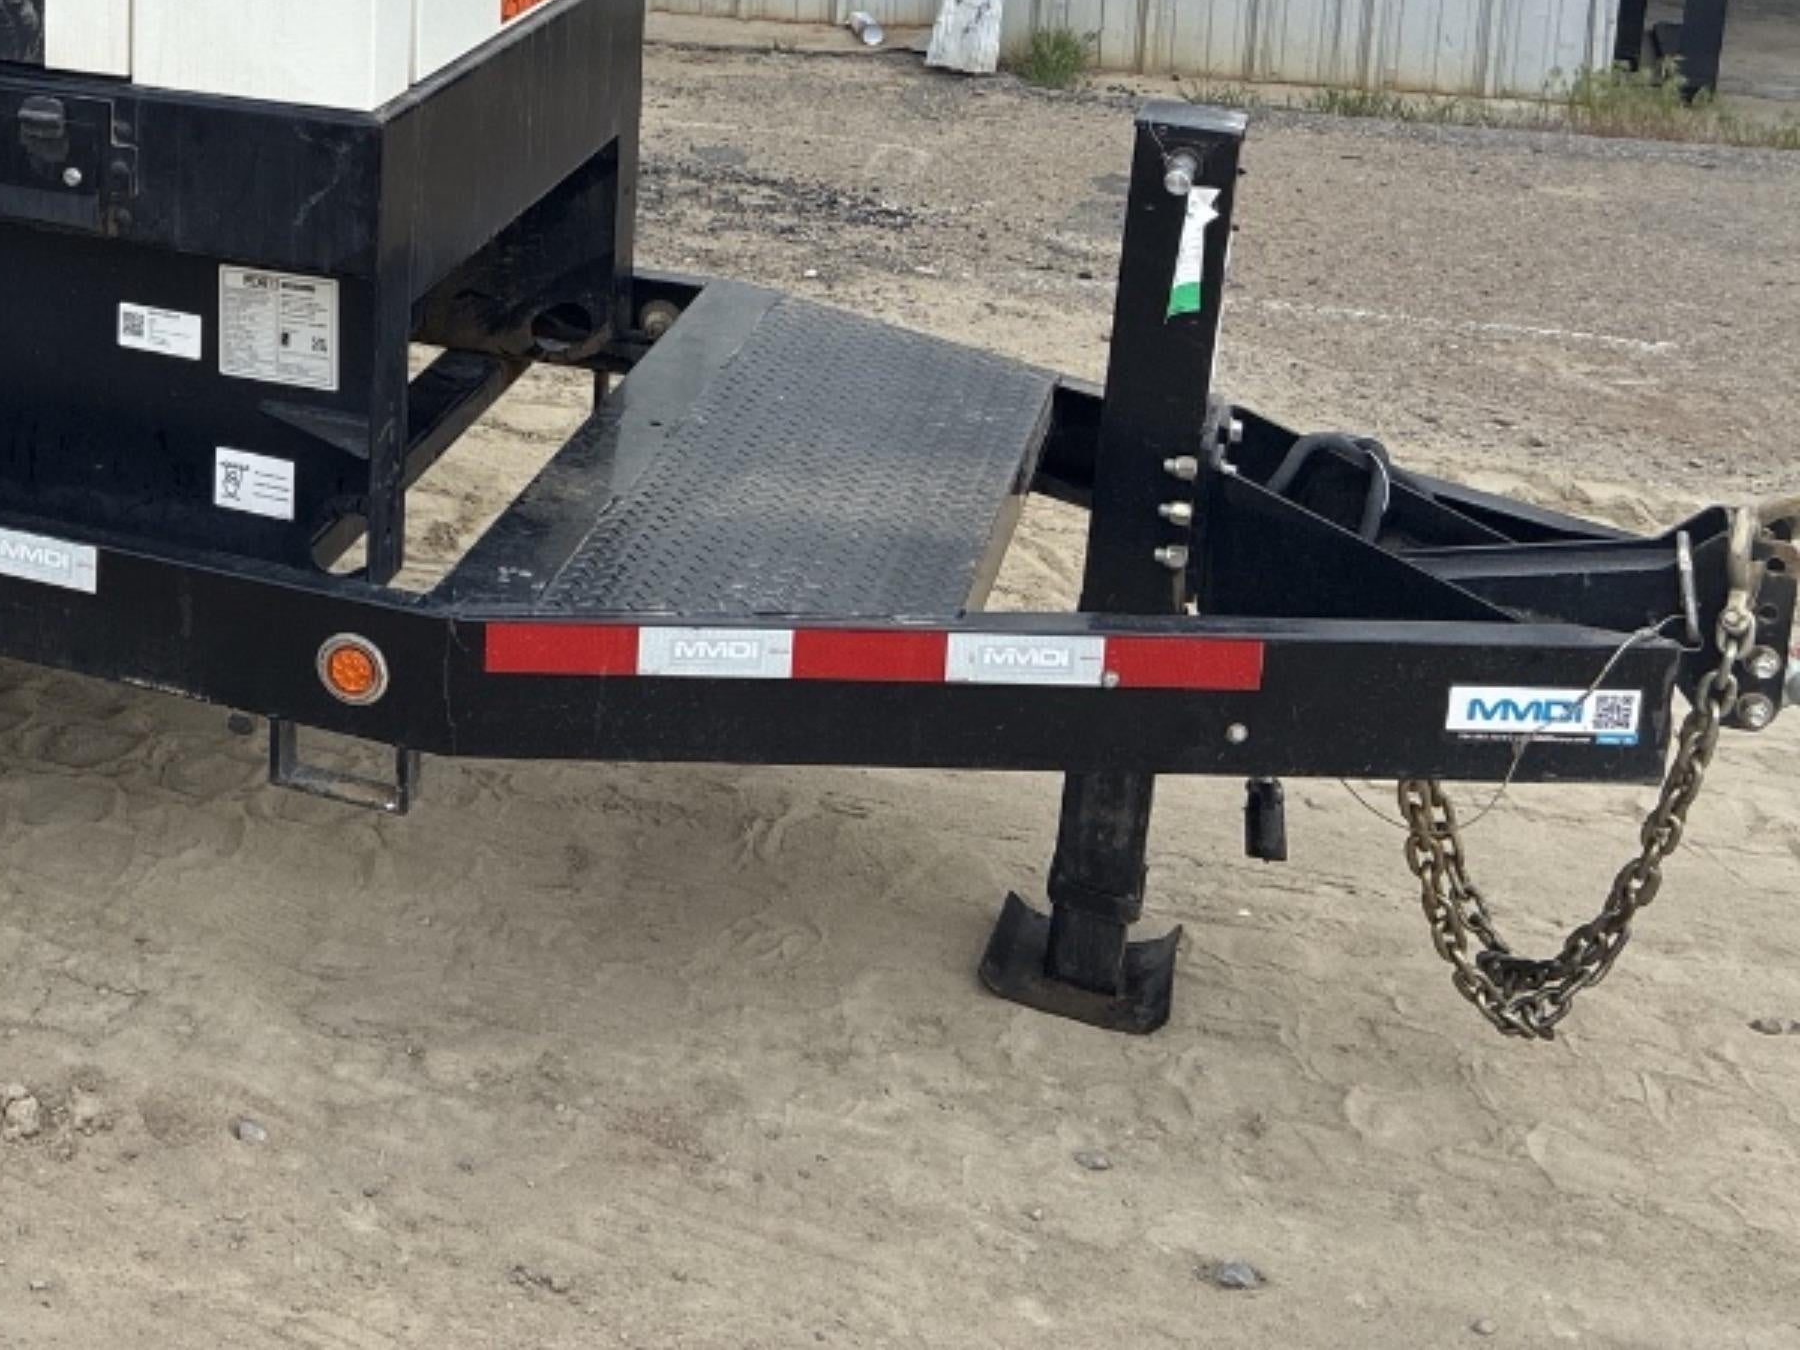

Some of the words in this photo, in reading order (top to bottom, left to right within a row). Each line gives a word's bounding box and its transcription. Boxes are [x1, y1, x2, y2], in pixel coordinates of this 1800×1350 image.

[675, 641, 757, 660] MMDI
[983, 648, 1069, 666] MMDI
[1466, 699, 1583, 723] MMDI
